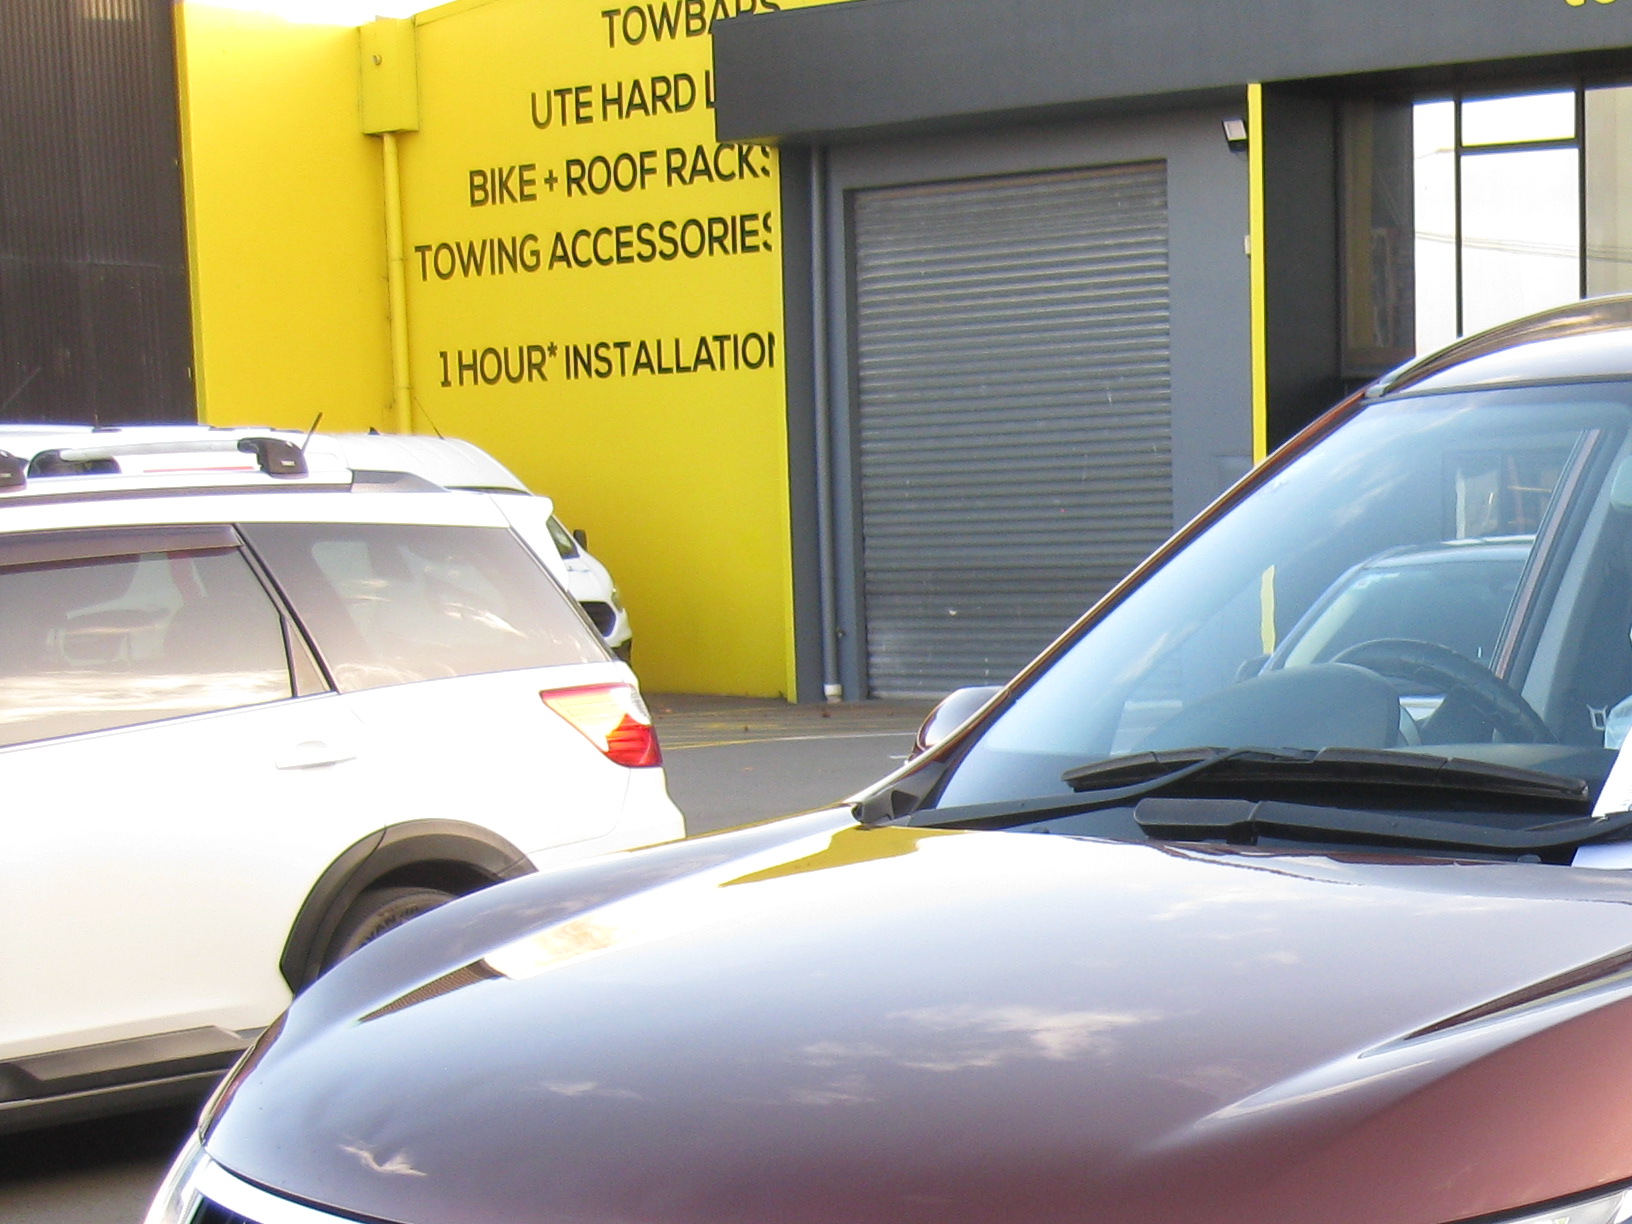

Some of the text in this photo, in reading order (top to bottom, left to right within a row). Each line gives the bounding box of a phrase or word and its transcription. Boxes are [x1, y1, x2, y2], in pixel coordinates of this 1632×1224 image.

[531, 85, 593, 130] UTE
[601, 73, 696, 121] HARD
[469, 164, 537, 207] BIKE
[566, 151, 657, 197] ROOF
[415, 234, 541, 282] TOWING
[439, 351, 452, 388] 1
